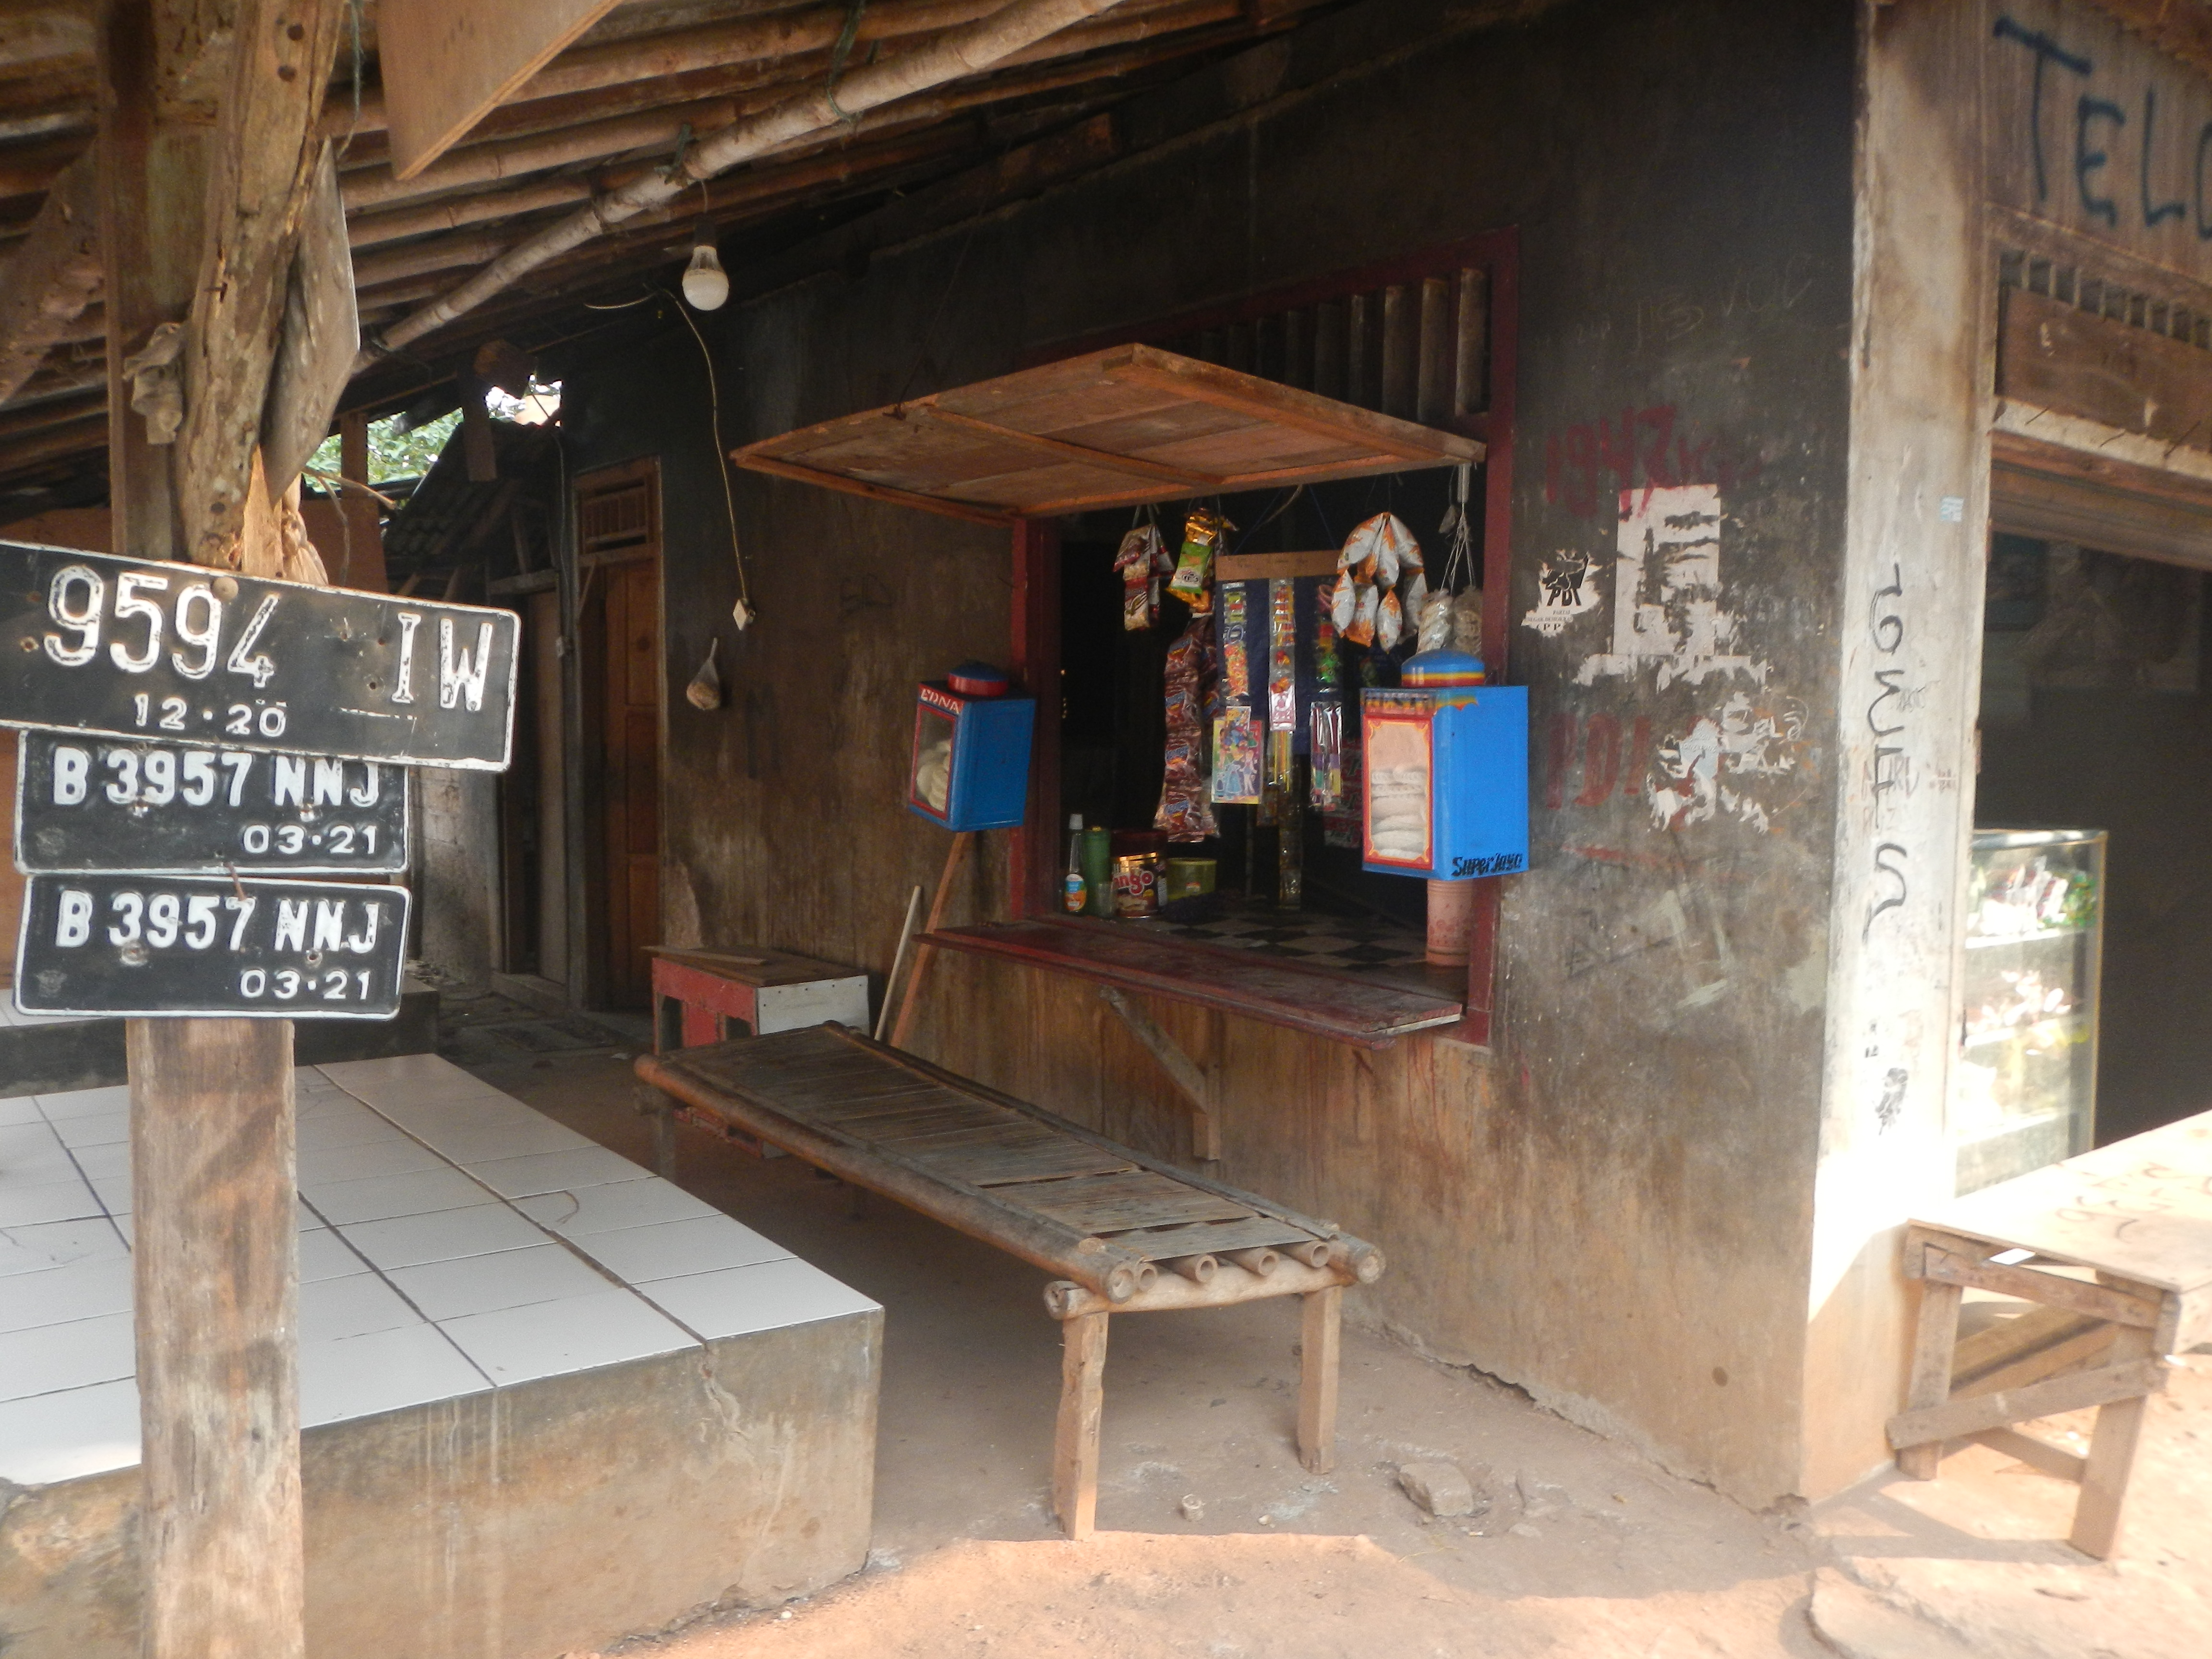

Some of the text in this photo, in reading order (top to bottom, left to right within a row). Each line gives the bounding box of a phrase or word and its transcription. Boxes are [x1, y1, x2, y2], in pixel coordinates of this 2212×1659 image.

[44, 564, 280, 689] 9594
[52, 746, 380, 807] B 3957 NNJ
[56, 889, 377, 954] B 3957 NNJ
